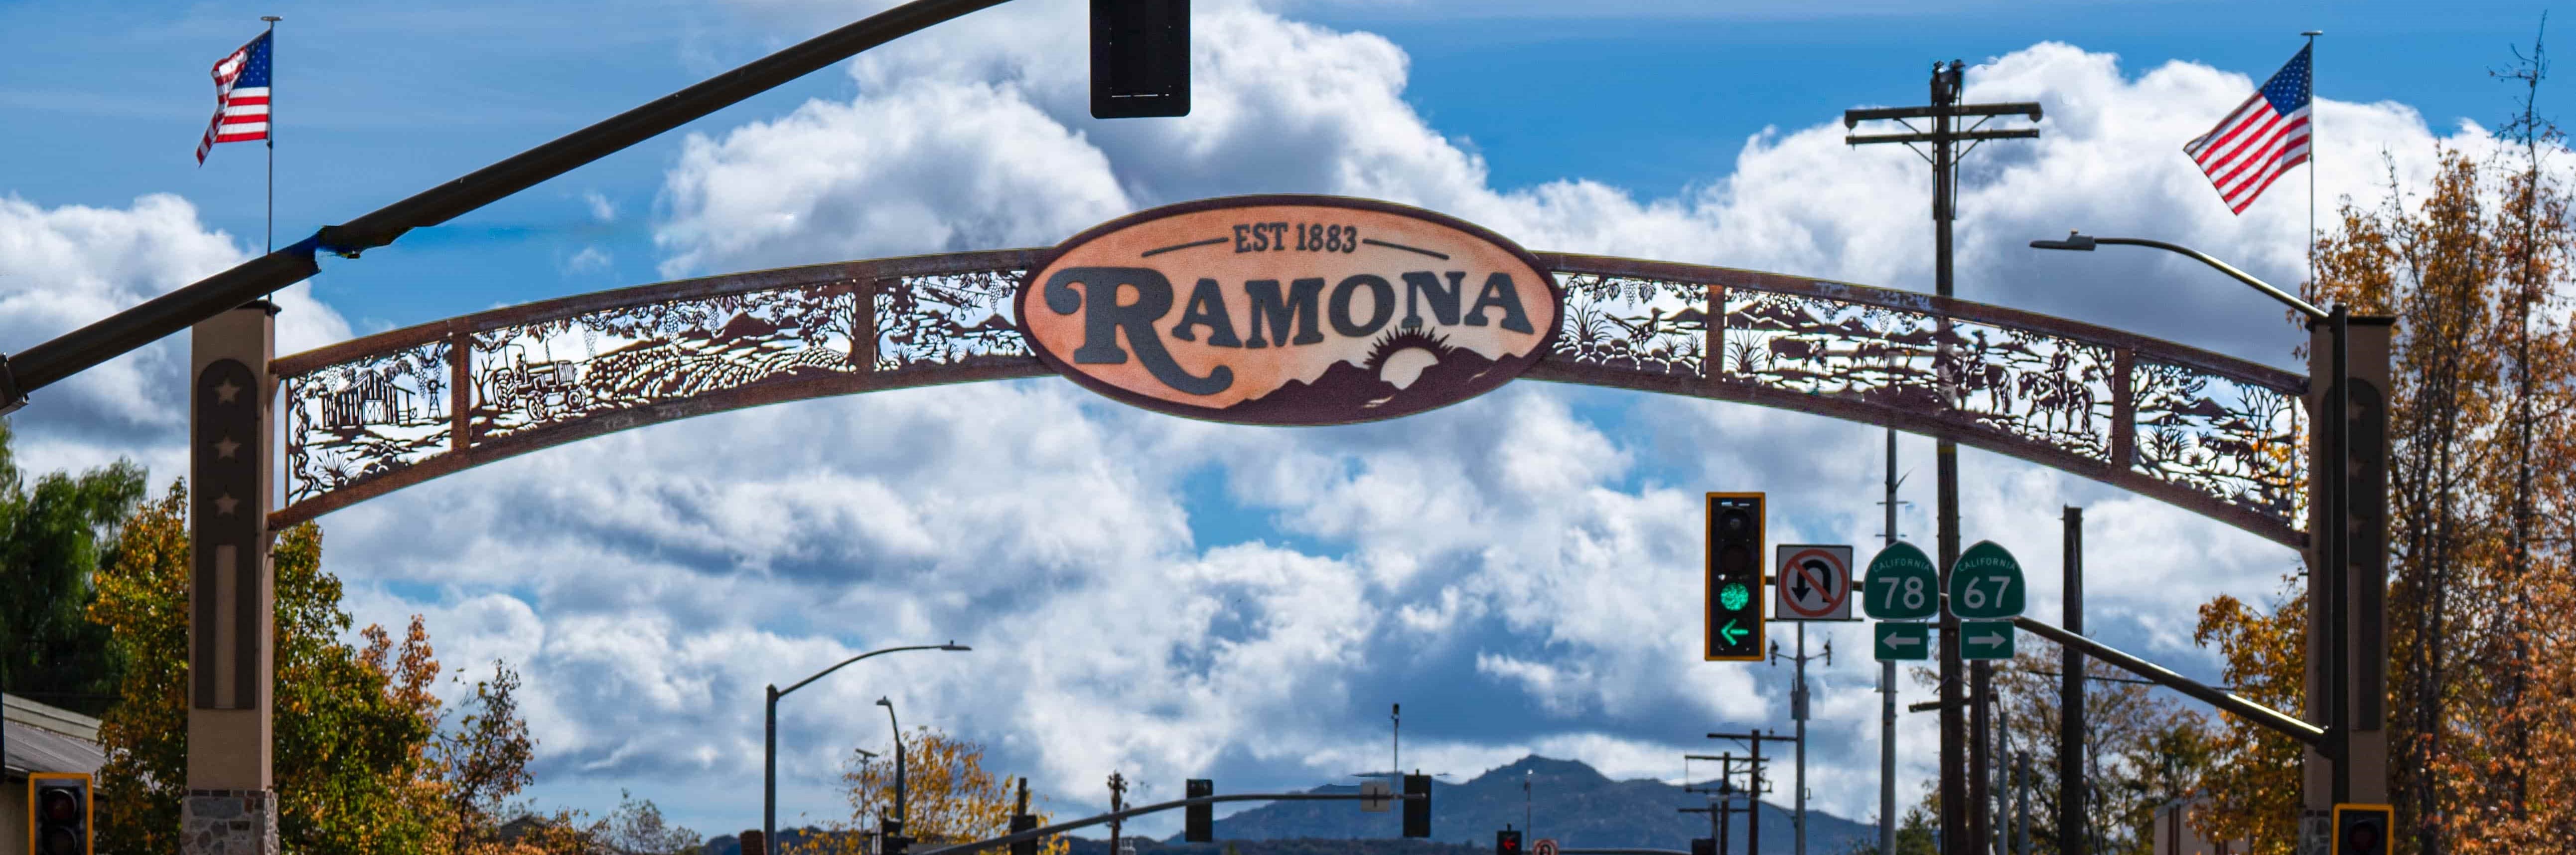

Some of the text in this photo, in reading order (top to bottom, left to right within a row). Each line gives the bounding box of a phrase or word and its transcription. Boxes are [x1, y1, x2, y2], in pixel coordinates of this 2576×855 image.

[1233, 221, 1357, 253] EST 1883
[1044, 266, 1535, 395] RAMONA
[1873, 558, 1930, 573] CALIFORNIA
[1958, 557, 2017, 572] CALIFORNIA
[1878, 576, 1925, 609] 78
[1964, 576, 2011, 609] 67
